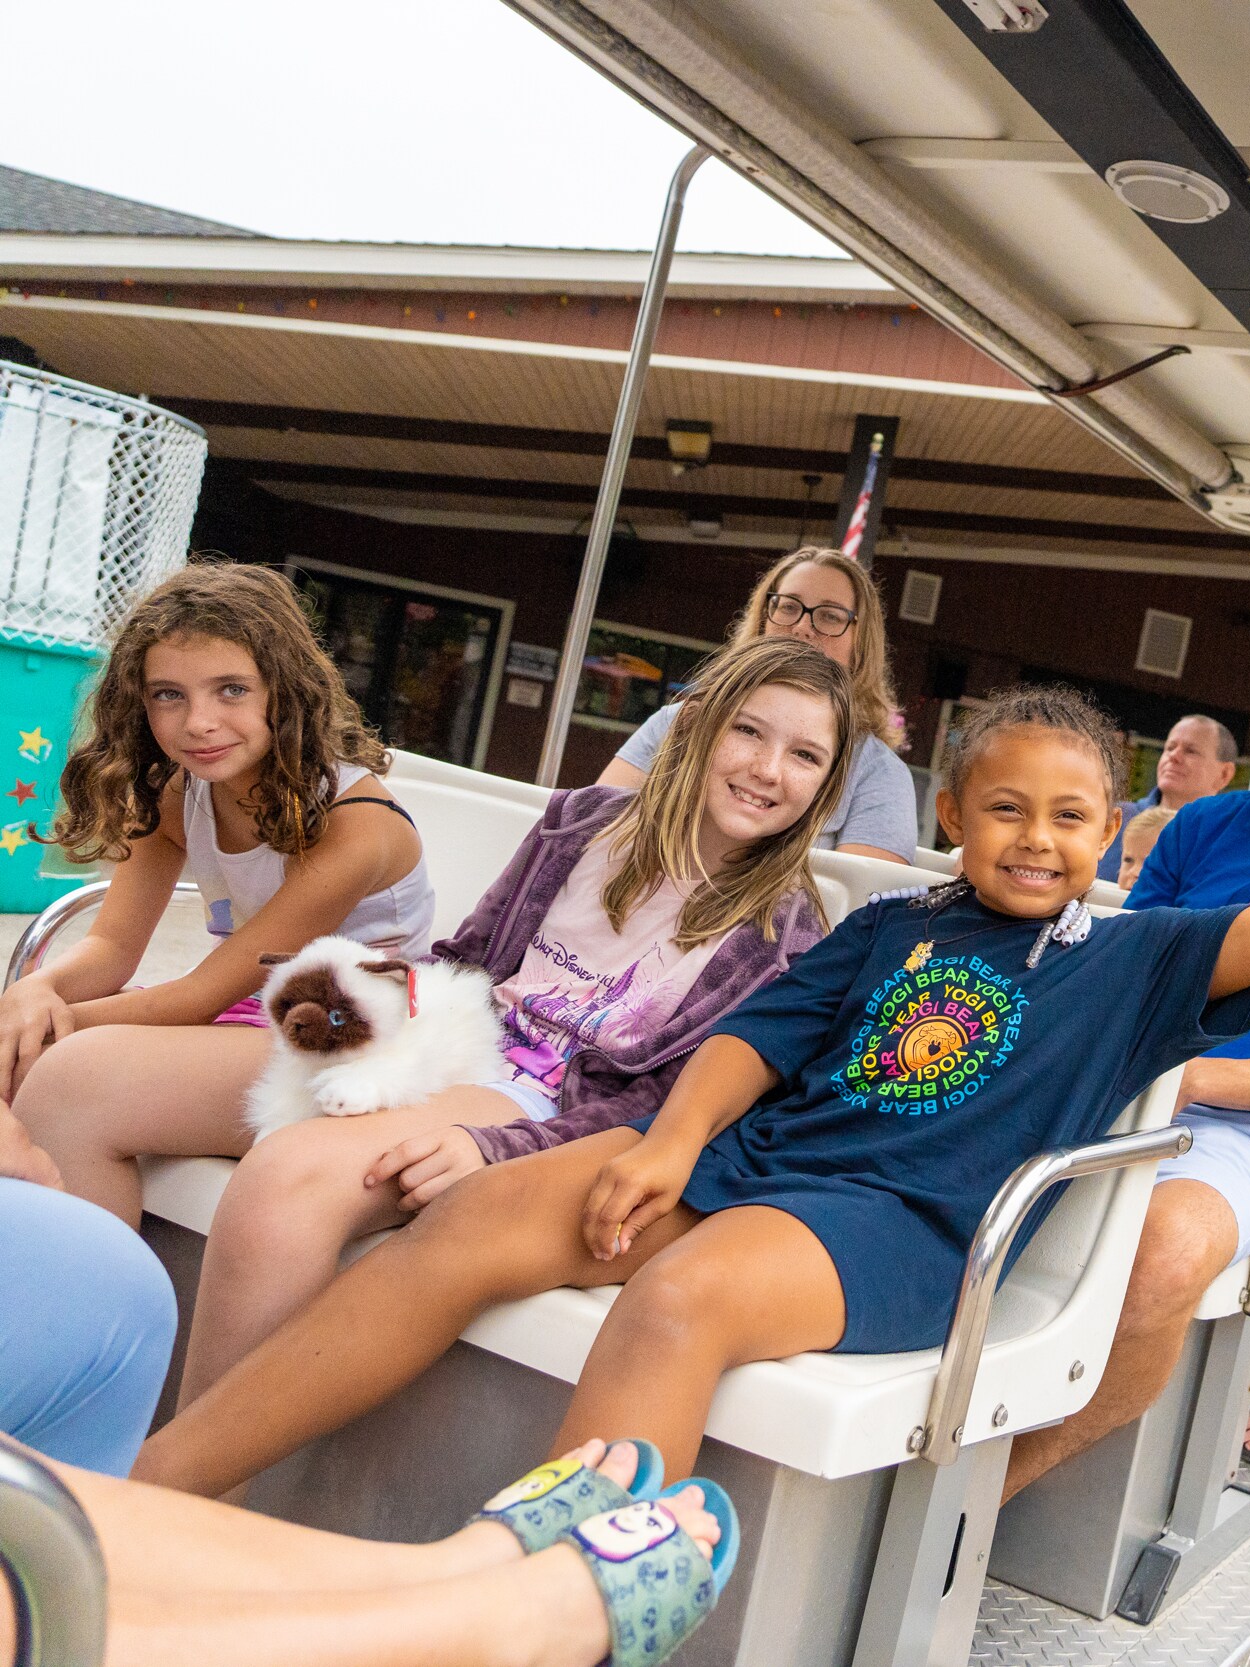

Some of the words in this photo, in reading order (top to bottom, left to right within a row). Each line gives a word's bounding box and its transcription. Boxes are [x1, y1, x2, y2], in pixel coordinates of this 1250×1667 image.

[915, 967, 970, 989] BEAR
[968, 955, 1012, 991] BEAR
[865, 968, 908, 1016] BEAR
[878, 982, 913, 1028] YOGI
[944, 984, 987, 1012] YOGI
[974, 979, 1012, 1014] YOGI
[917, 1049, 969, 1082] YOGI
[942, 1049, 990, 1090] YOGI
[877, 1081, 938, 1098] BEAR
[943, 1073, 991, 1110] YOGI
[878, 1099, 938, 1116] BEAR
